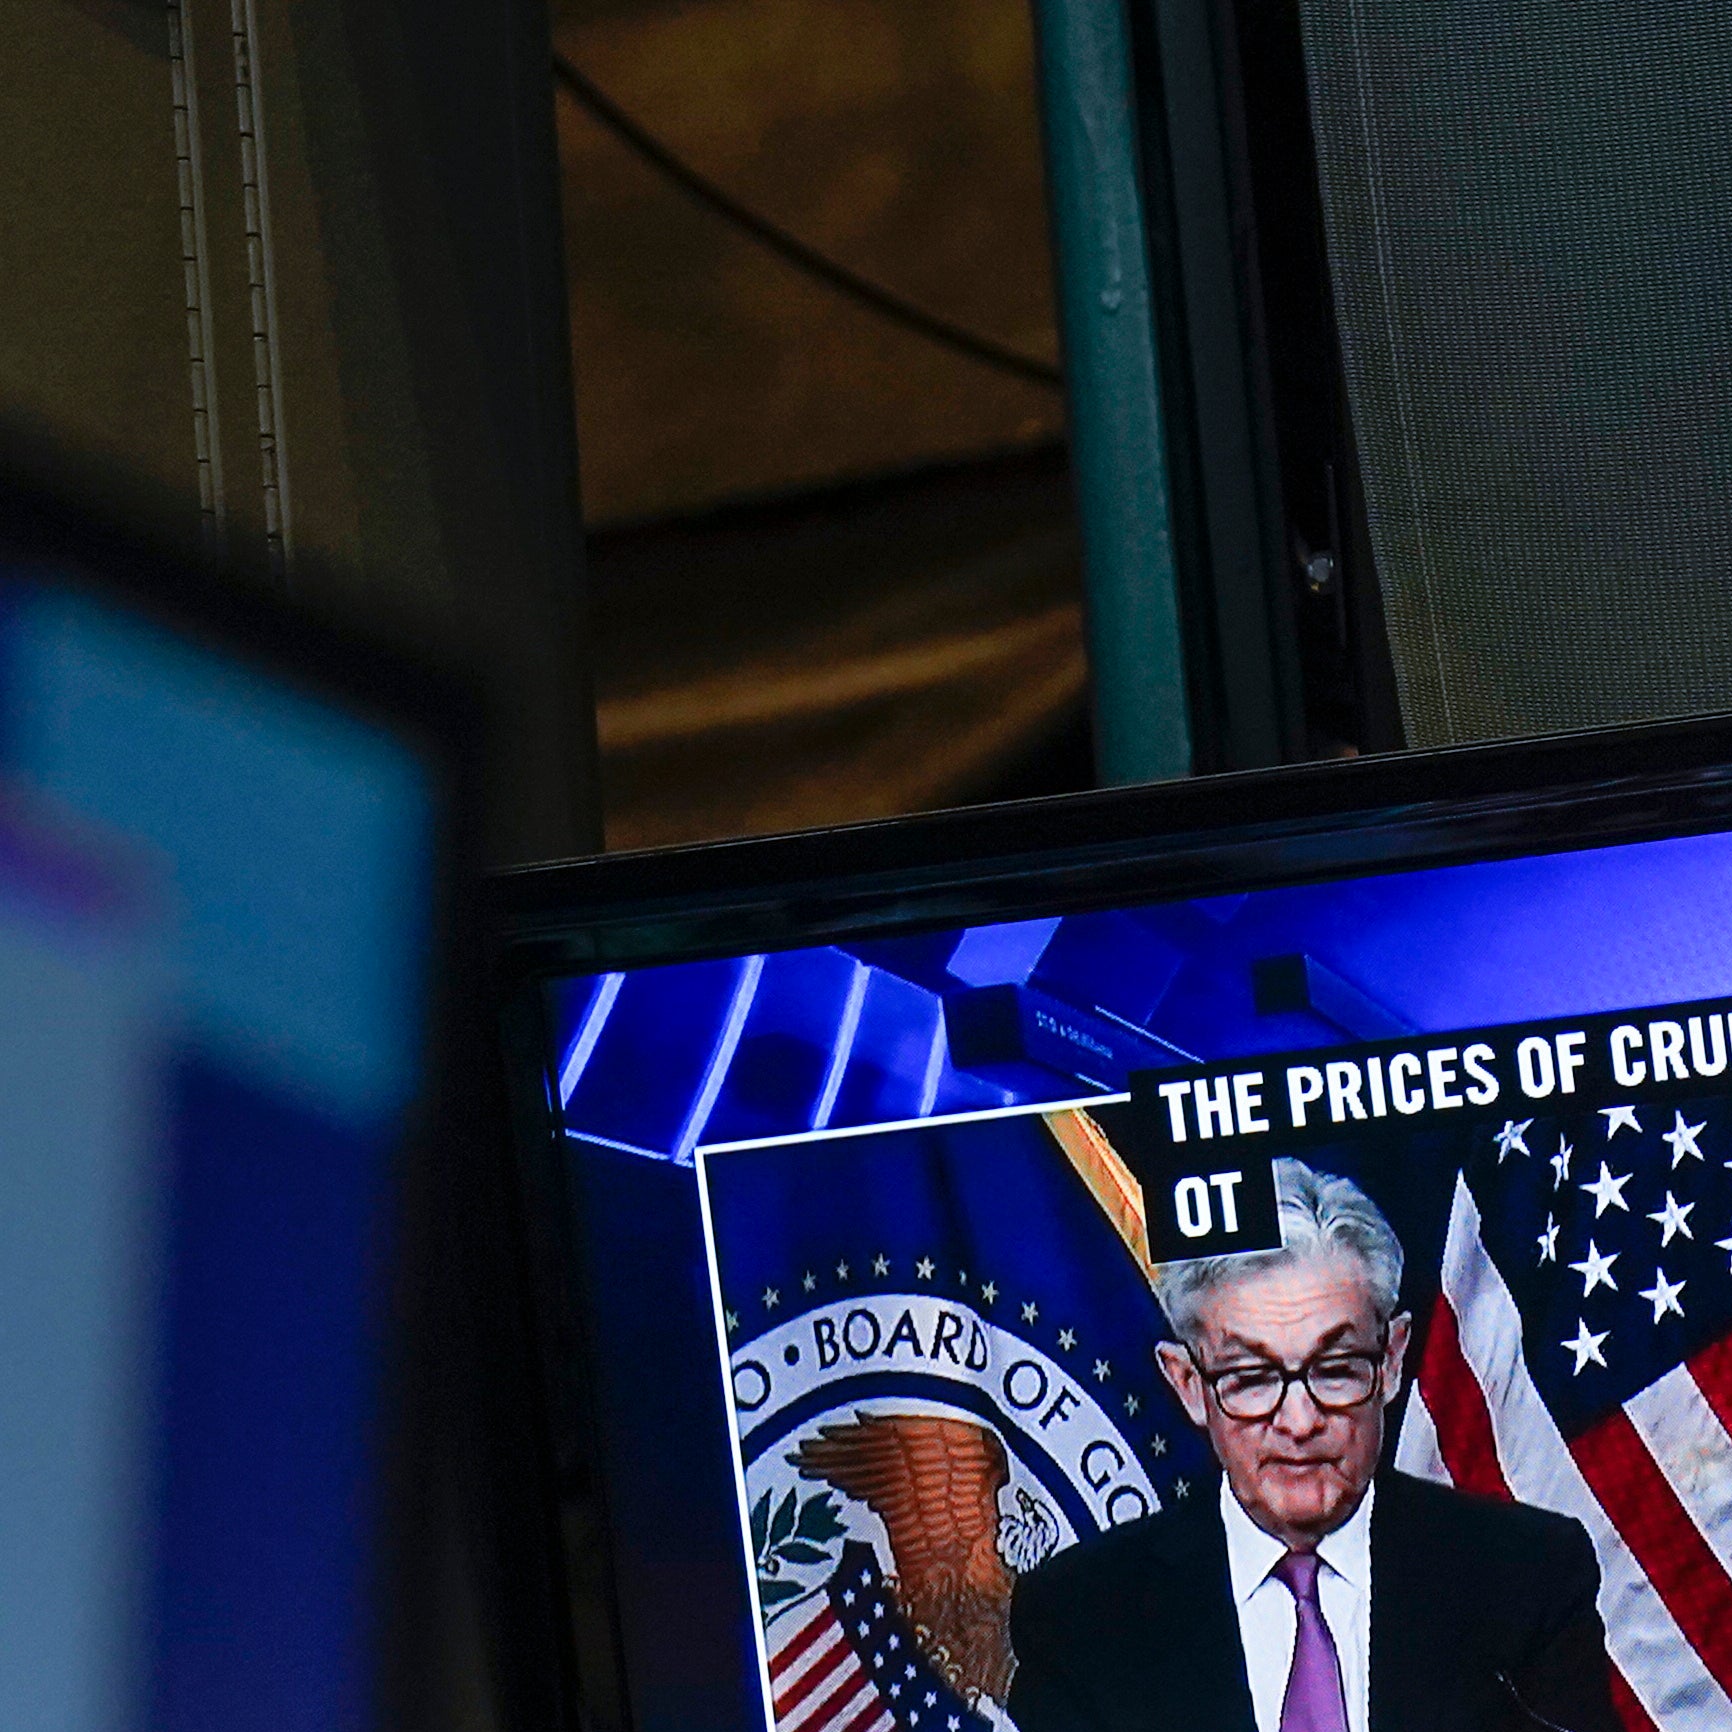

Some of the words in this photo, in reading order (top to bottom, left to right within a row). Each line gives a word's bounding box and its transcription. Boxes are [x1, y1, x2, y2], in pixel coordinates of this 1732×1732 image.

[1158, 1072, 1270, 1143] THE
[1287, 1043, 1500, 1128] PRICES
[1516, 1031, 1587, 1098] OF
[1173, 1171, 1243, 1239] OT
[814, 1308, 989, 1372] BOARD
[1002, 1358, 1082, 1430] OF
